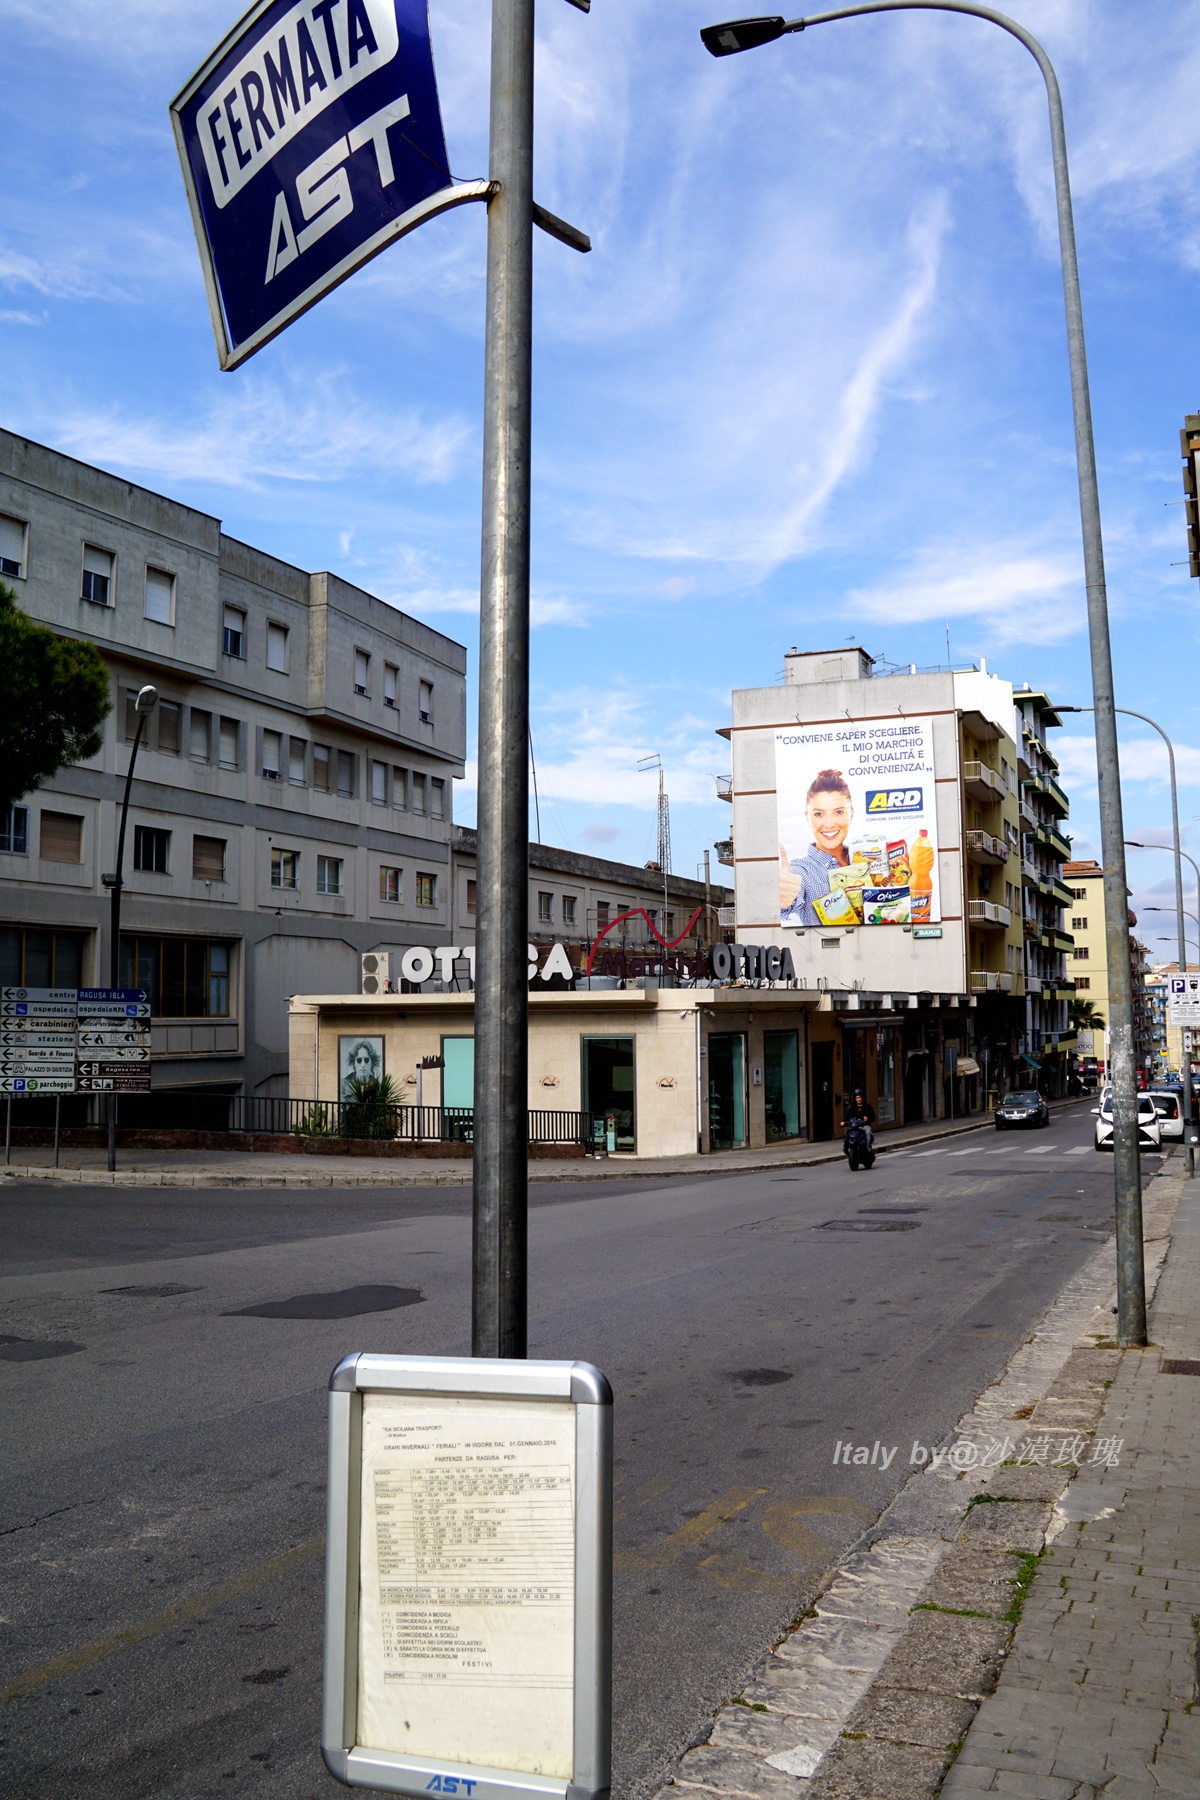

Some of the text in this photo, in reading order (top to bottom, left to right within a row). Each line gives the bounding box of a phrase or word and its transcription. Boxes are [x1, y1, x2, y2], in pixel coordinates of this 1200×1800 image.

[208, 0, 379, 188] FERMATA
[264, 93, 411, 285] AST
[835, 731, 866, 741] SAPER
[869, 726, 923, 739] SCEGLIERE.
[842, 738, 924, 752] IL MIO MARCHIO
[859, 755, 869, 763] DI
[918, 750, 924, 759] E
[868, 790, 921, 808] ARD
[600, 952, 703, 977] Marchi
[709, 942, 796, 981] OTTICA
[1173, 981, 1184, 993] P
[80, 991, 125, 1000] RAGUSA IBLA
[16, 1080, 23, 1089] P
[40, 1081, 73, 1089] parcheggio
[425, 1774, 477, 1796] AST
